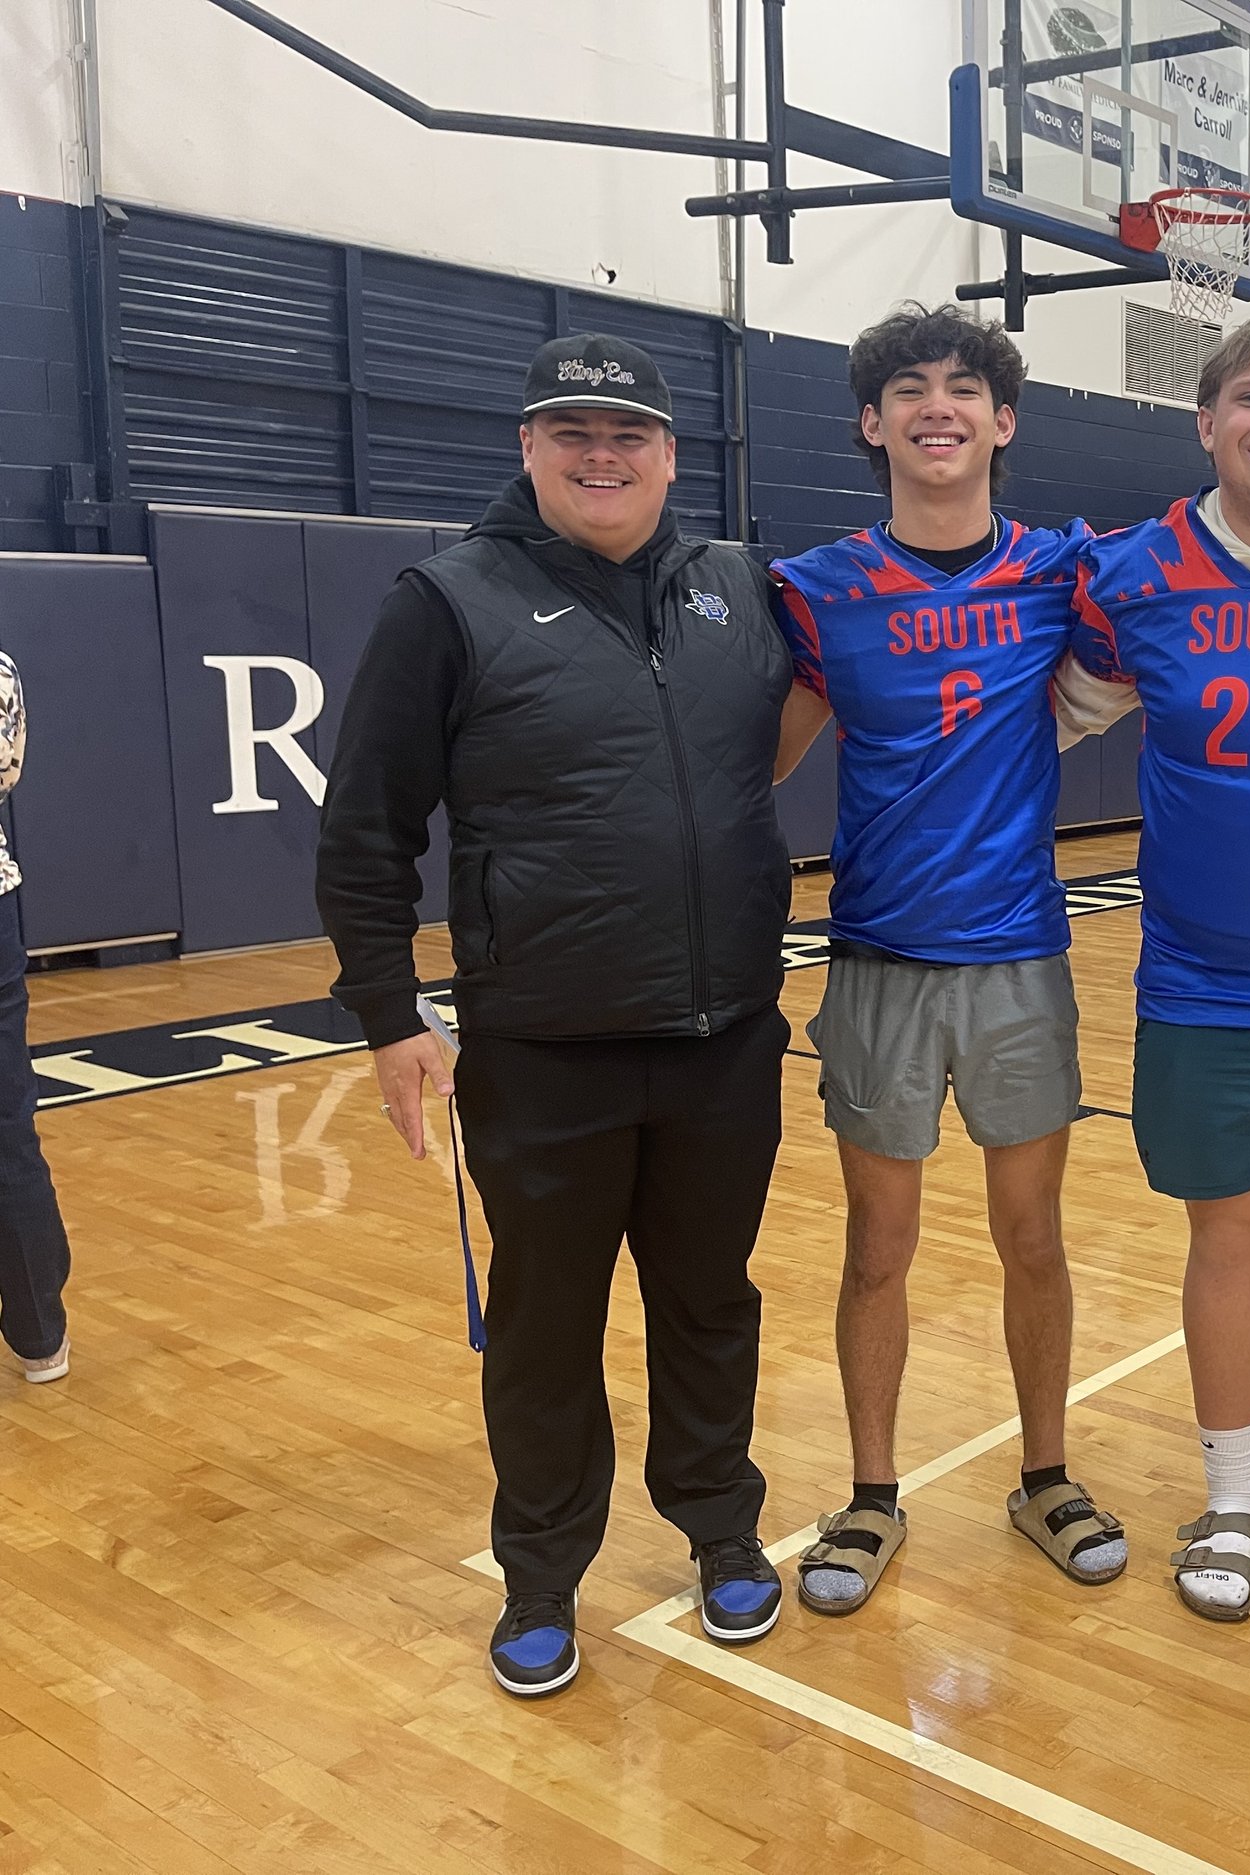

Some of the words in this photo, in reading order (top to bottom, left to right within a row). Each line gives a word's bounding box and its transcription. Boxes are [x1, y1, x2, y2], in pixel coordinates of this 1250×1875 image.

[1164, 59, 1194, 93] Marc
[1197, 75, 1207, 99] &
[1034, 109, 1062, 129] PROUD
[1092, 130, 1121, 150] SPONSO
[1194, 106, 1232, 140] Carroll
[888, 601, 1022, 655] SOUTH
[1194, 1571, 1229, 1582] DRI-FIT
